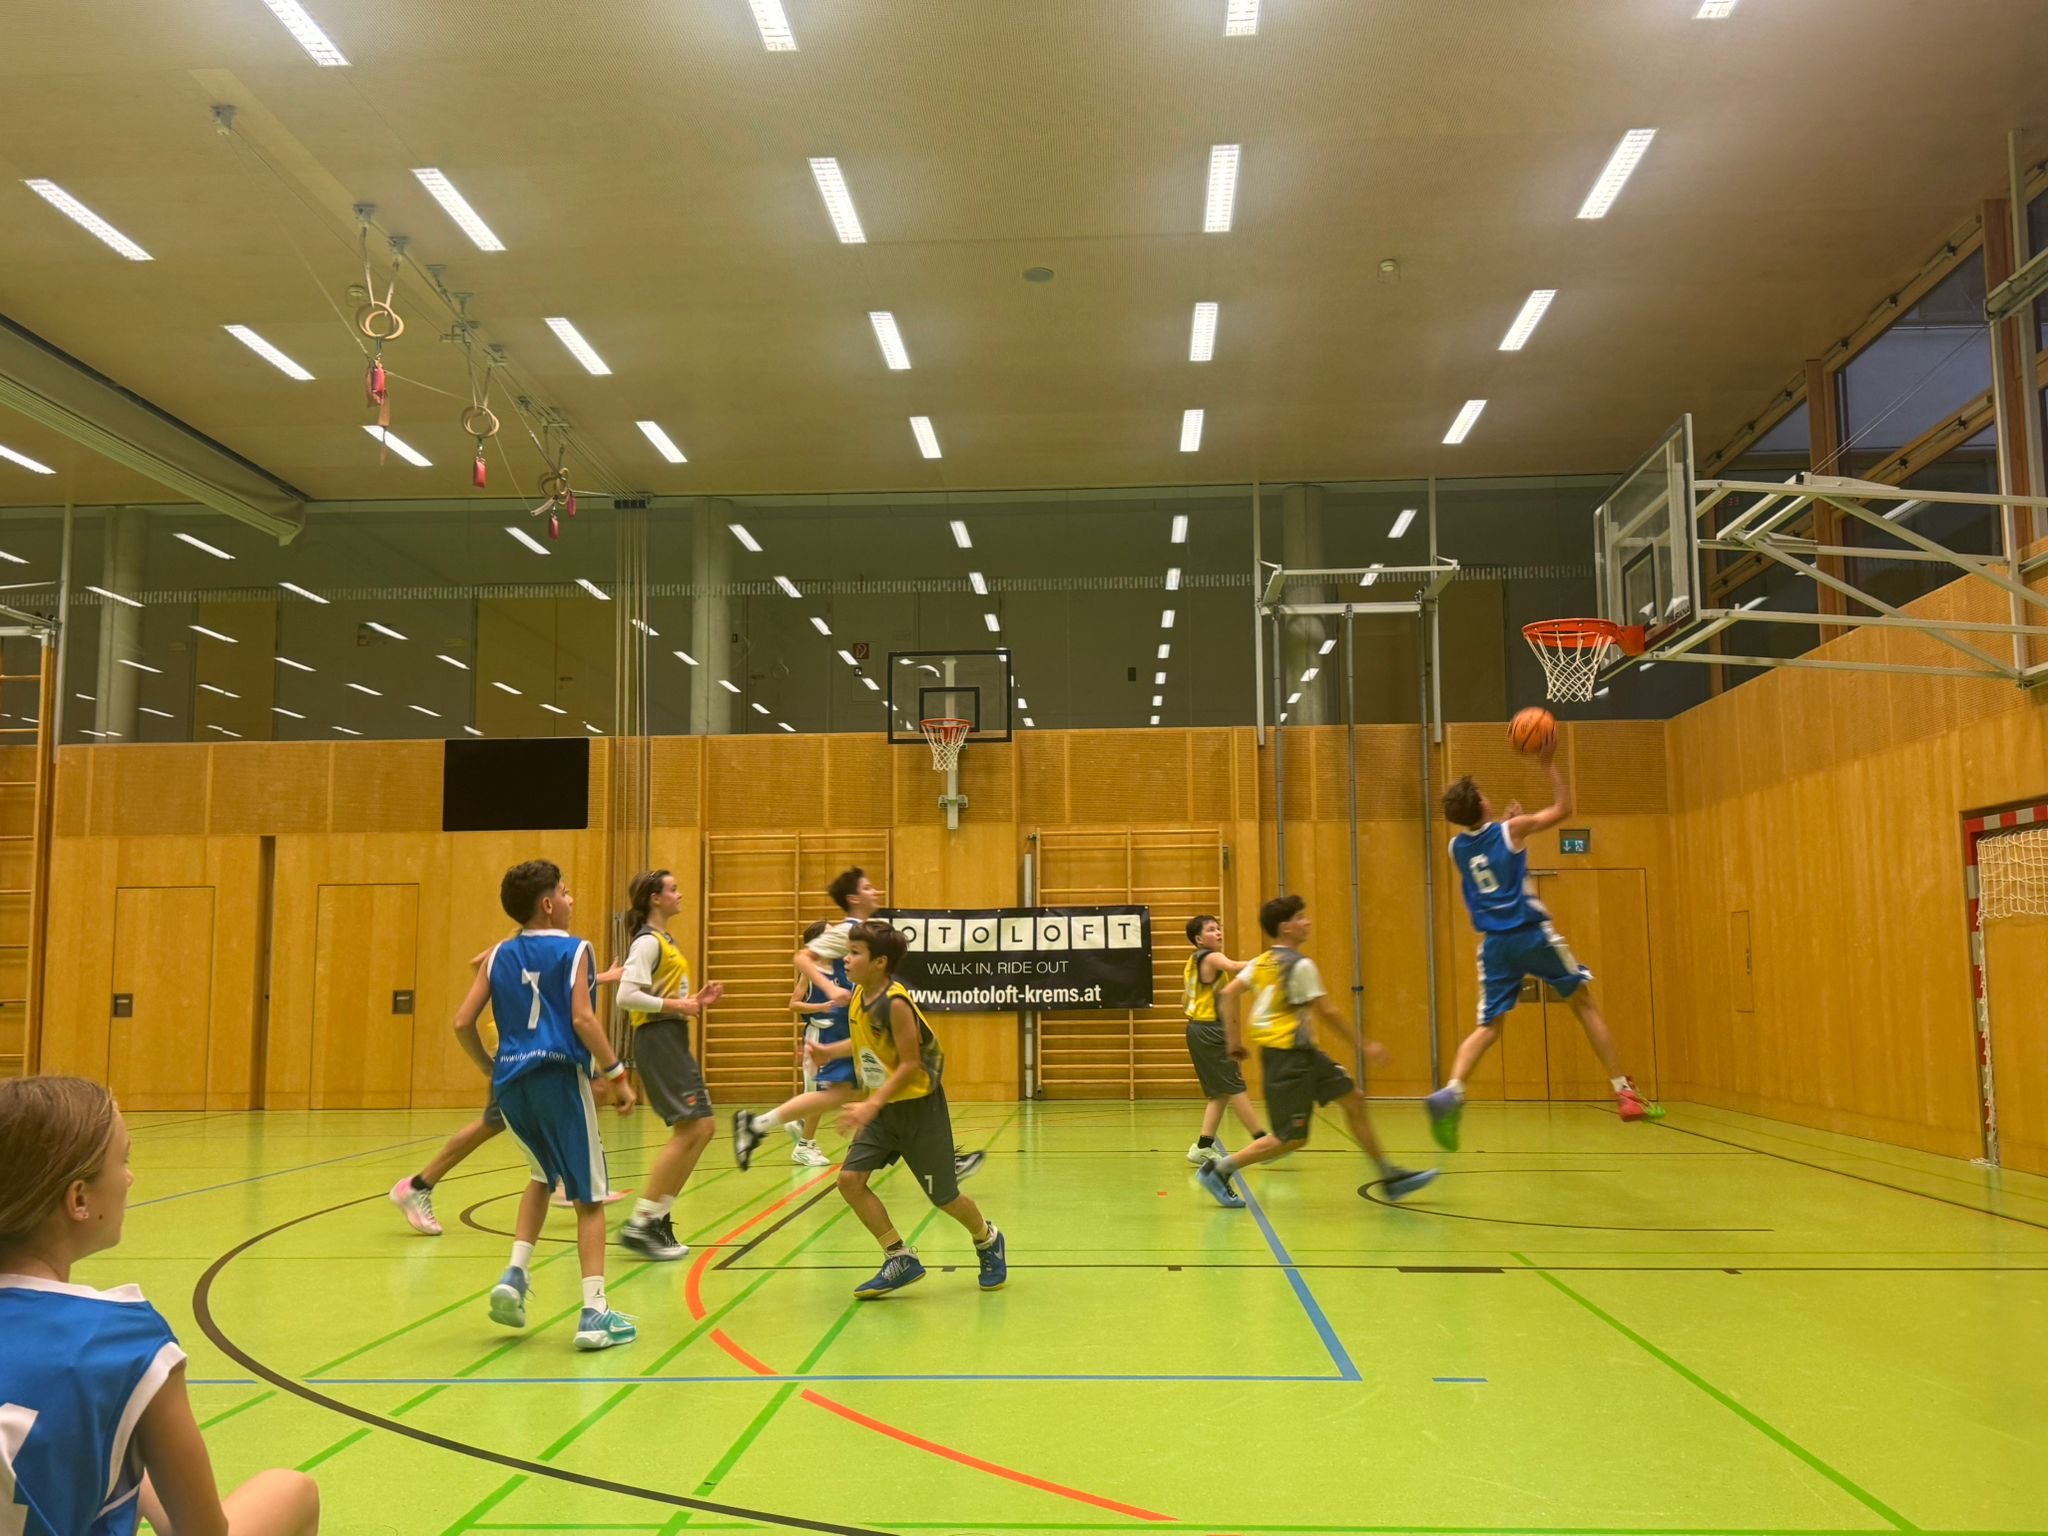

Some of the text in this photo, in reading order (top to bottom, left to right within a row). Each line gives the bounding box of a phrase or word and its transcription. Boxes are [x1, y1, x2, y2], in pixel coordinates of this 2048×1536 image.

[1469, 853, 1500, 894] 6
[901, 922, 1131, 944] OTOLOFT
[927, 960, 1069, 976] WALK IN, RIDE OUT
[908, 984, 1101, 1003] ww.motoloft-krems.at
